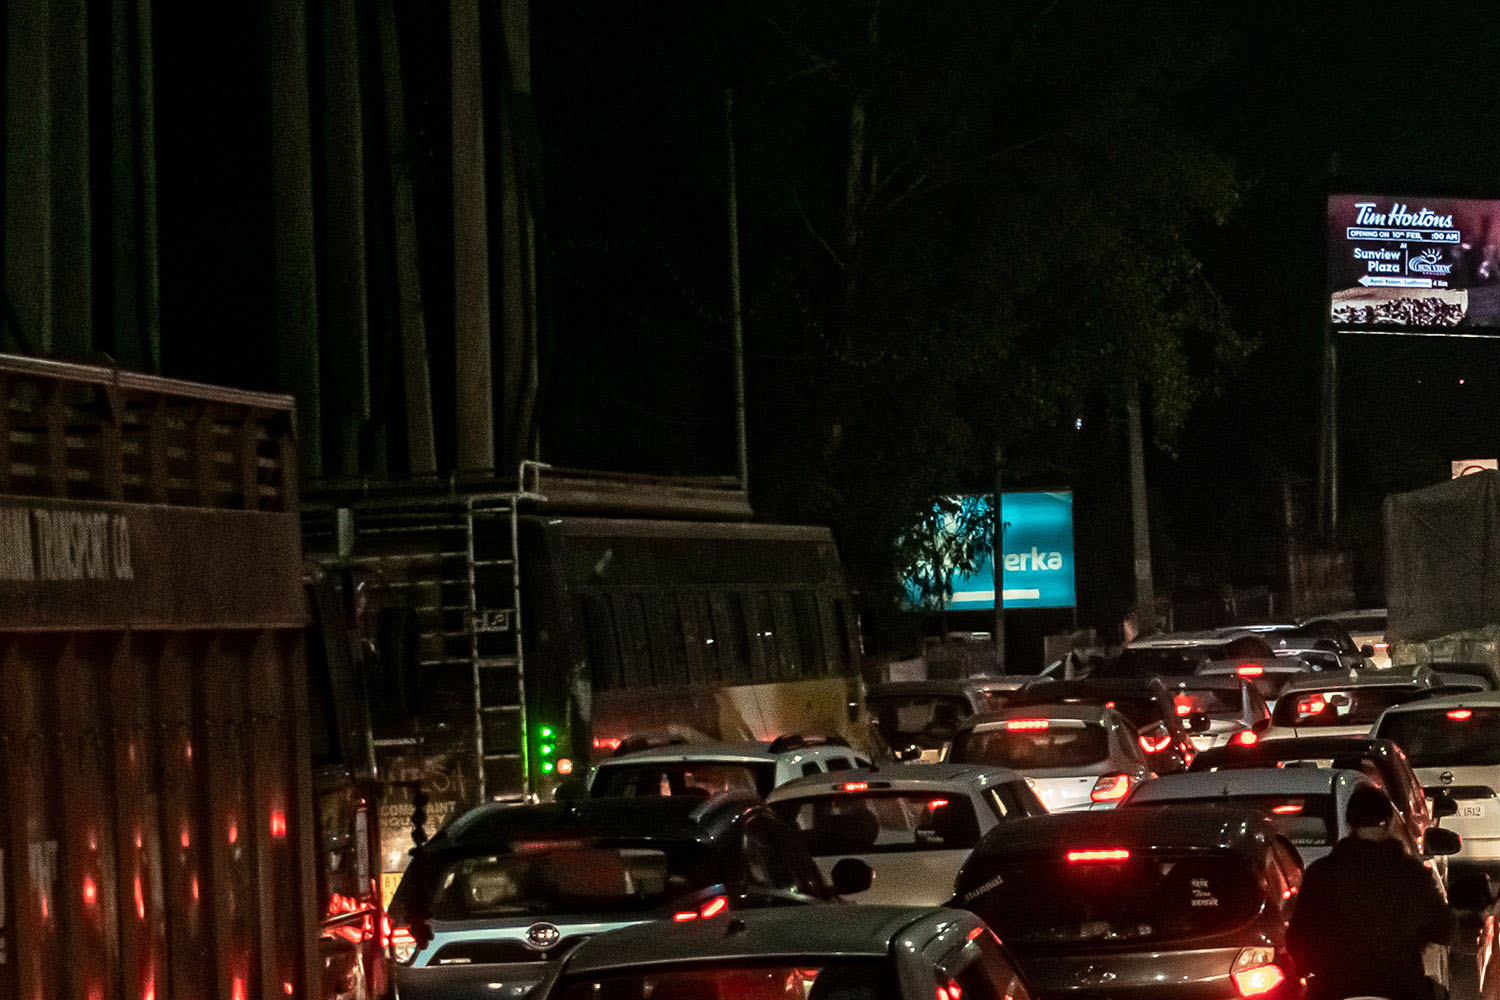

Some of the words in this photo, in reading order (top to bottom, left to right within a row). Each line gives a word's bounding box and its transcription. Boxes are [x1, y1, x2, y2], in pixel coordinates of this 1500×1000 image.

[1354, 202, 1386, 226] Tim
[1387, 203, 1453, 228] Hortons
[1350, 230, 1379, 238] OPENING
[1379, 231, 1390, 239] ON
[1446, 233, 1458, 241] AM
[1354, 248, 1400, 260] Sunview
[1367, 260, 1400, 273] Plaza
[1001, 546, 1063, 572] erka
